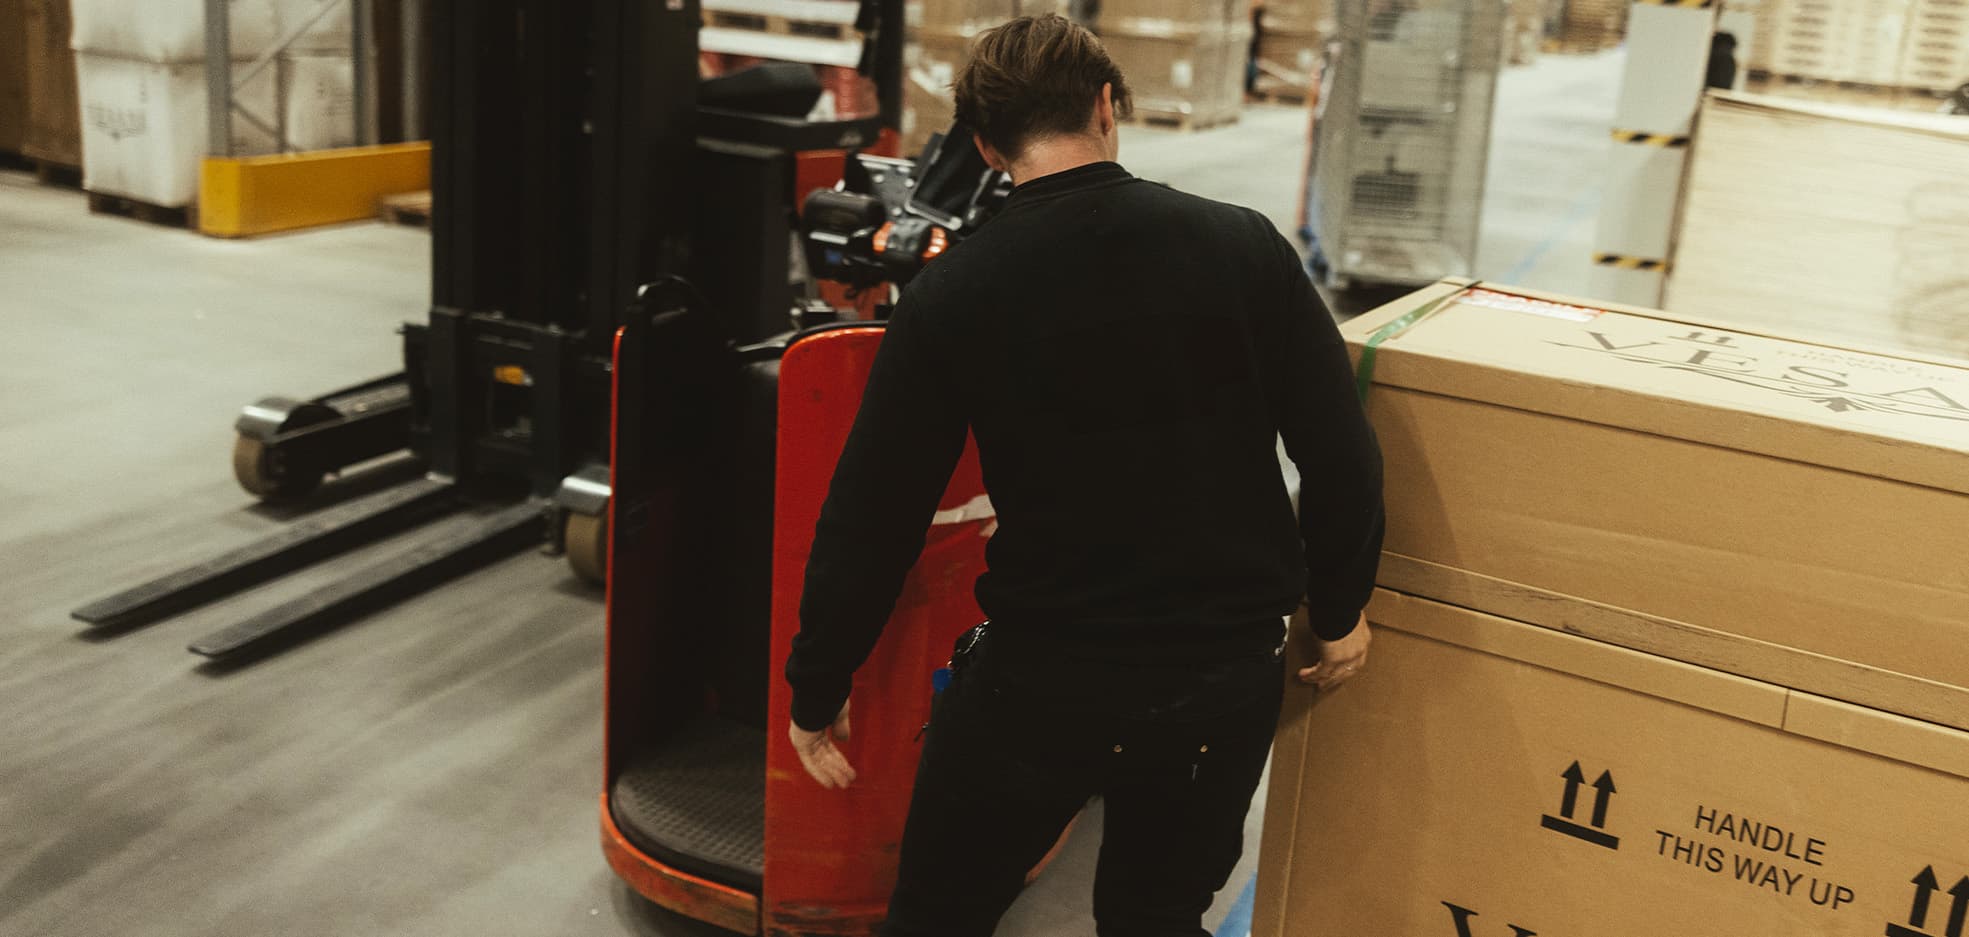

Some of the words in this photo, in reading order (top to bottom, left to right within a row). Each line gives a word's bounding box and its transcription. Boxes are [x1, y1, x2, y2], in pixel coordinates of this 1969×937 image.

[1656, 829, 1725, 873] THIS
[1734, 854, 1804, 896] WAY
[1809, 878, 1855, 910] UP
[1694, 805, 1827, 866] HANDLE
